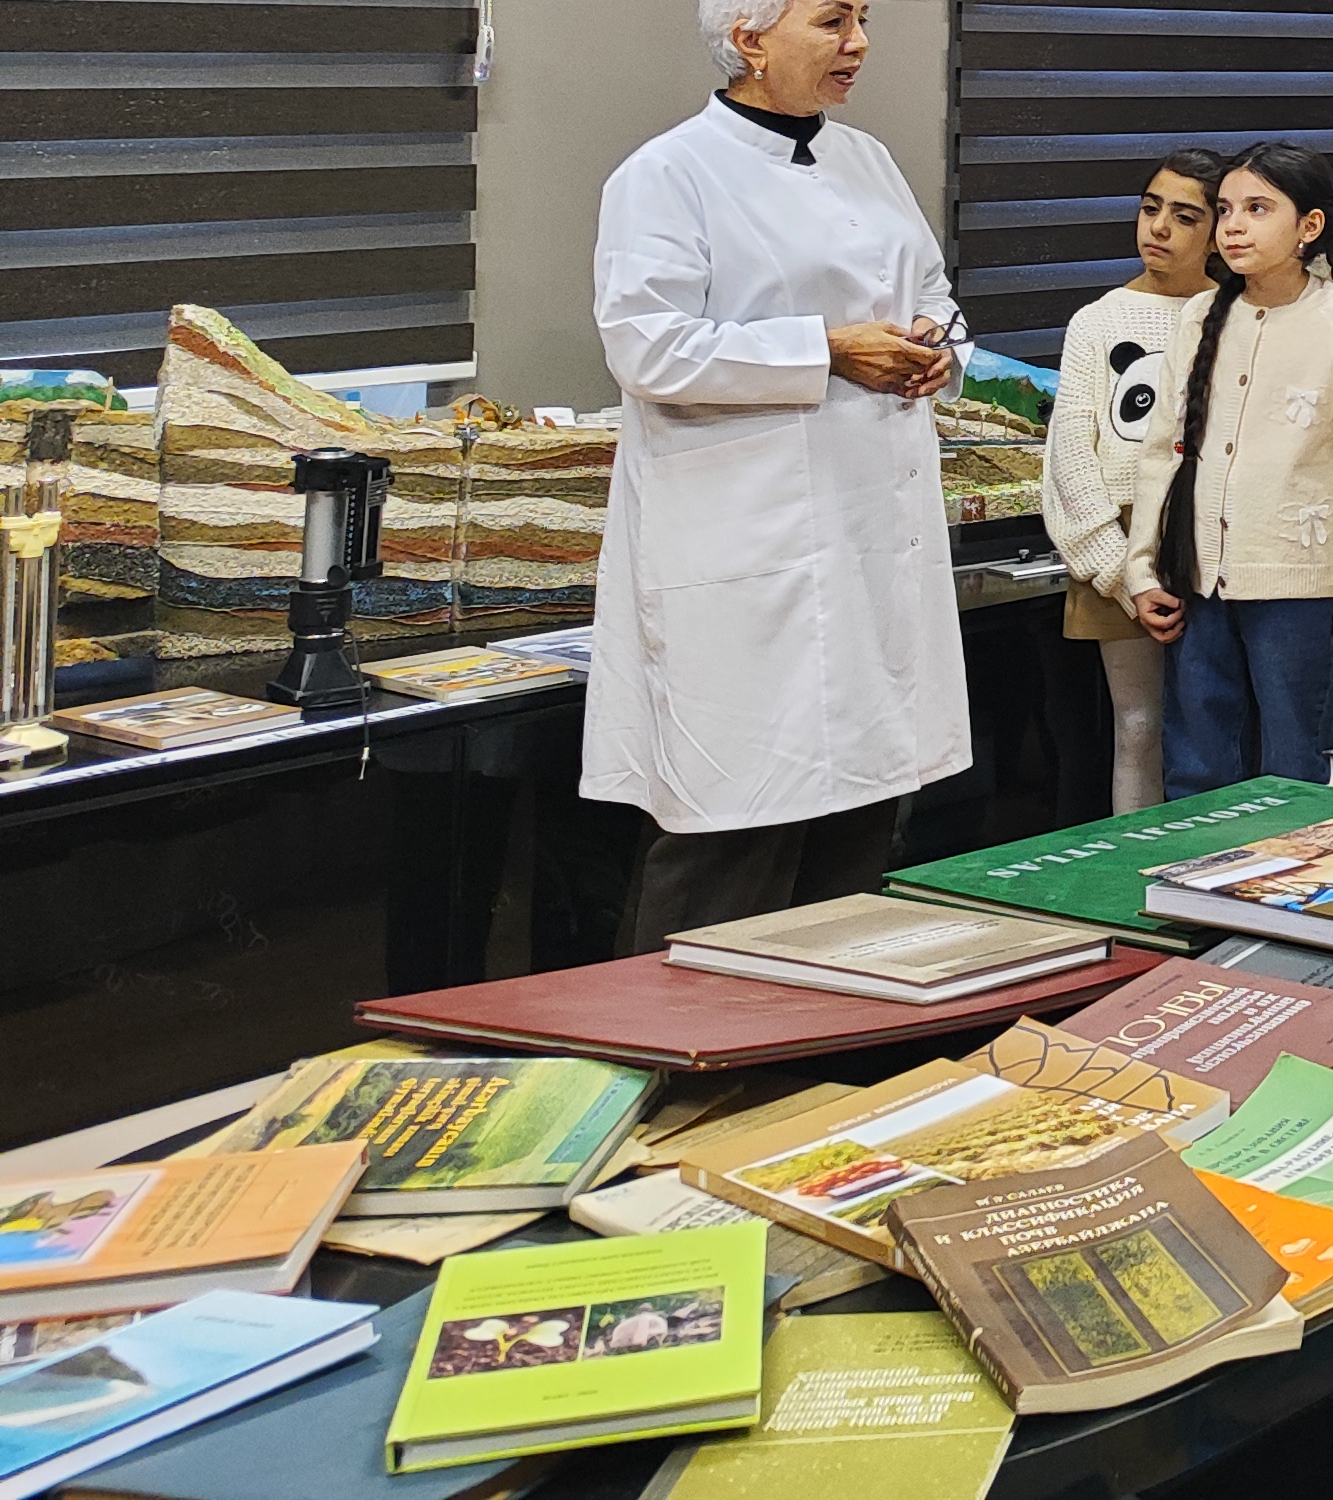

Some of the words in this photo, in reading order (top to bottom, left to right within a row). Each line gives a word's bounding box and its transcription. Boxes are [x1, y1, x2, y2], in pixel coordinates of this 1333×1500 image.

[986, 840, 1118, 879] ATLAS
[1207, 989, 1266, 1026] полосы
[1242, 1007, 1259, 1017] и
[1256, 993, 1282, 1008] их
[933, 1233, 953, 1246] И
[959, 1182, 1145, 1242] КЛАССИФИКАЦИЯ
[985, 1175, 1138, 1225] ДИАГНОСТИКА
[998, 1225, 1059, 1246] ПОЧВ
[1007, 1200, 1170, 1258] АЗЕРБАЙДЖАНА
